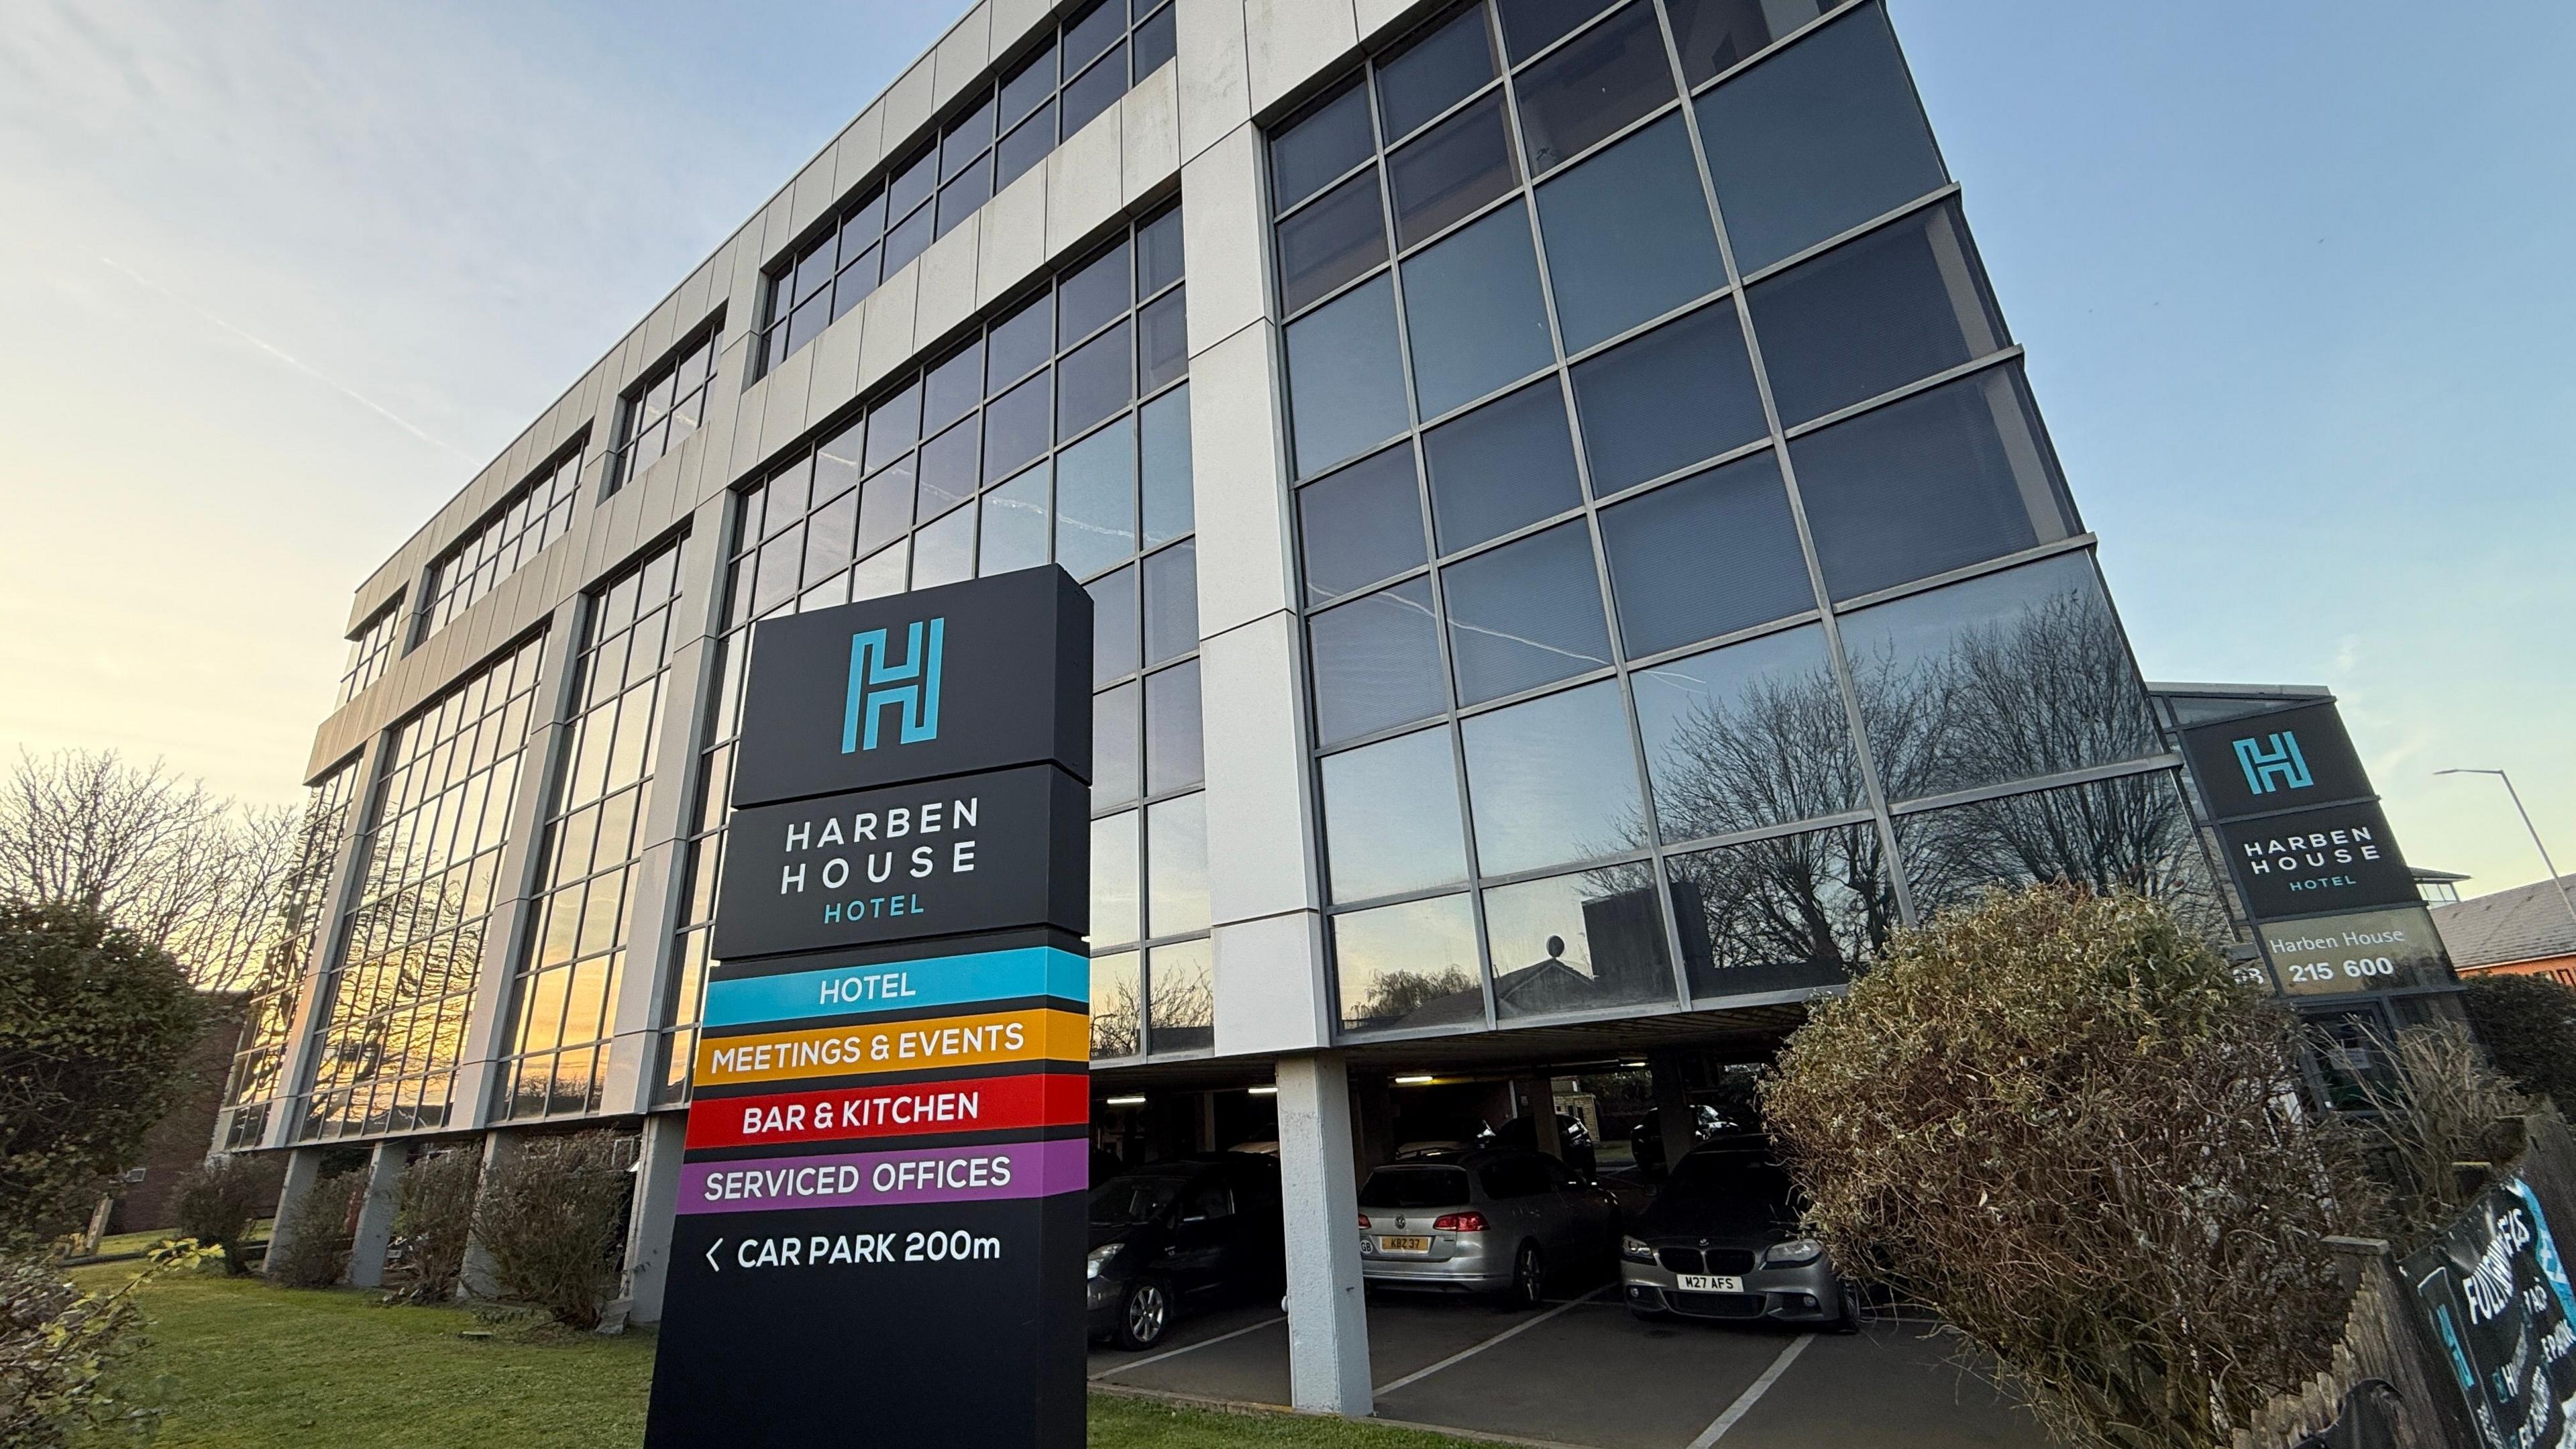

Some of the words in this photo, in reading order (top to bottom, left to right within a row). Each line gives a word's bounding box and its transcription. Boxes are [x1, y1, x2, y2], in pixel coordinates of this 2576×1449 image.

[786, 797, 977, 853] HARBEN
[2244, 826, 2371, 857] HARBEN
[780, 840, 975, 895] HOUSE
[2251, 845, 2380, 875] HOUSE
[2289, 875, 2357, 892] HOTEL
[824, 893, 924, 924] HOTEL
[2269, 936, 2339, 953] Harben
[2341, 929, 2405, 947] House
[2288, 962, 2334, 982] 215
[2343, 957, 2394, 977] 600
[820, 972, 916, 1004] HOTEL
[711, 1036, 861, 1074] MEETINGS
[871, 1034, 890, 1061] &
[899, 1022, 1024, 1059] EVENTS
[743, 1104, 806, 1134] BAR
[814, 1102, 833, 1129] &
[842, 1091, 979, 1127] KITCHEN
[704, 1165, 859, 1201] SERVICED
[873, 1156, 1011, 1192] OFFICES
[738, 1237, 802, 1268] CAR
[808, 1233, 896, 1265] PARK
[904, 1230, 1001, 1262] 200m
[1360, 1242, 1372, 1252] GB
[1685, 1276, 1707, 1289] M27
[1711, 1277, 1733, 1289] AFS
